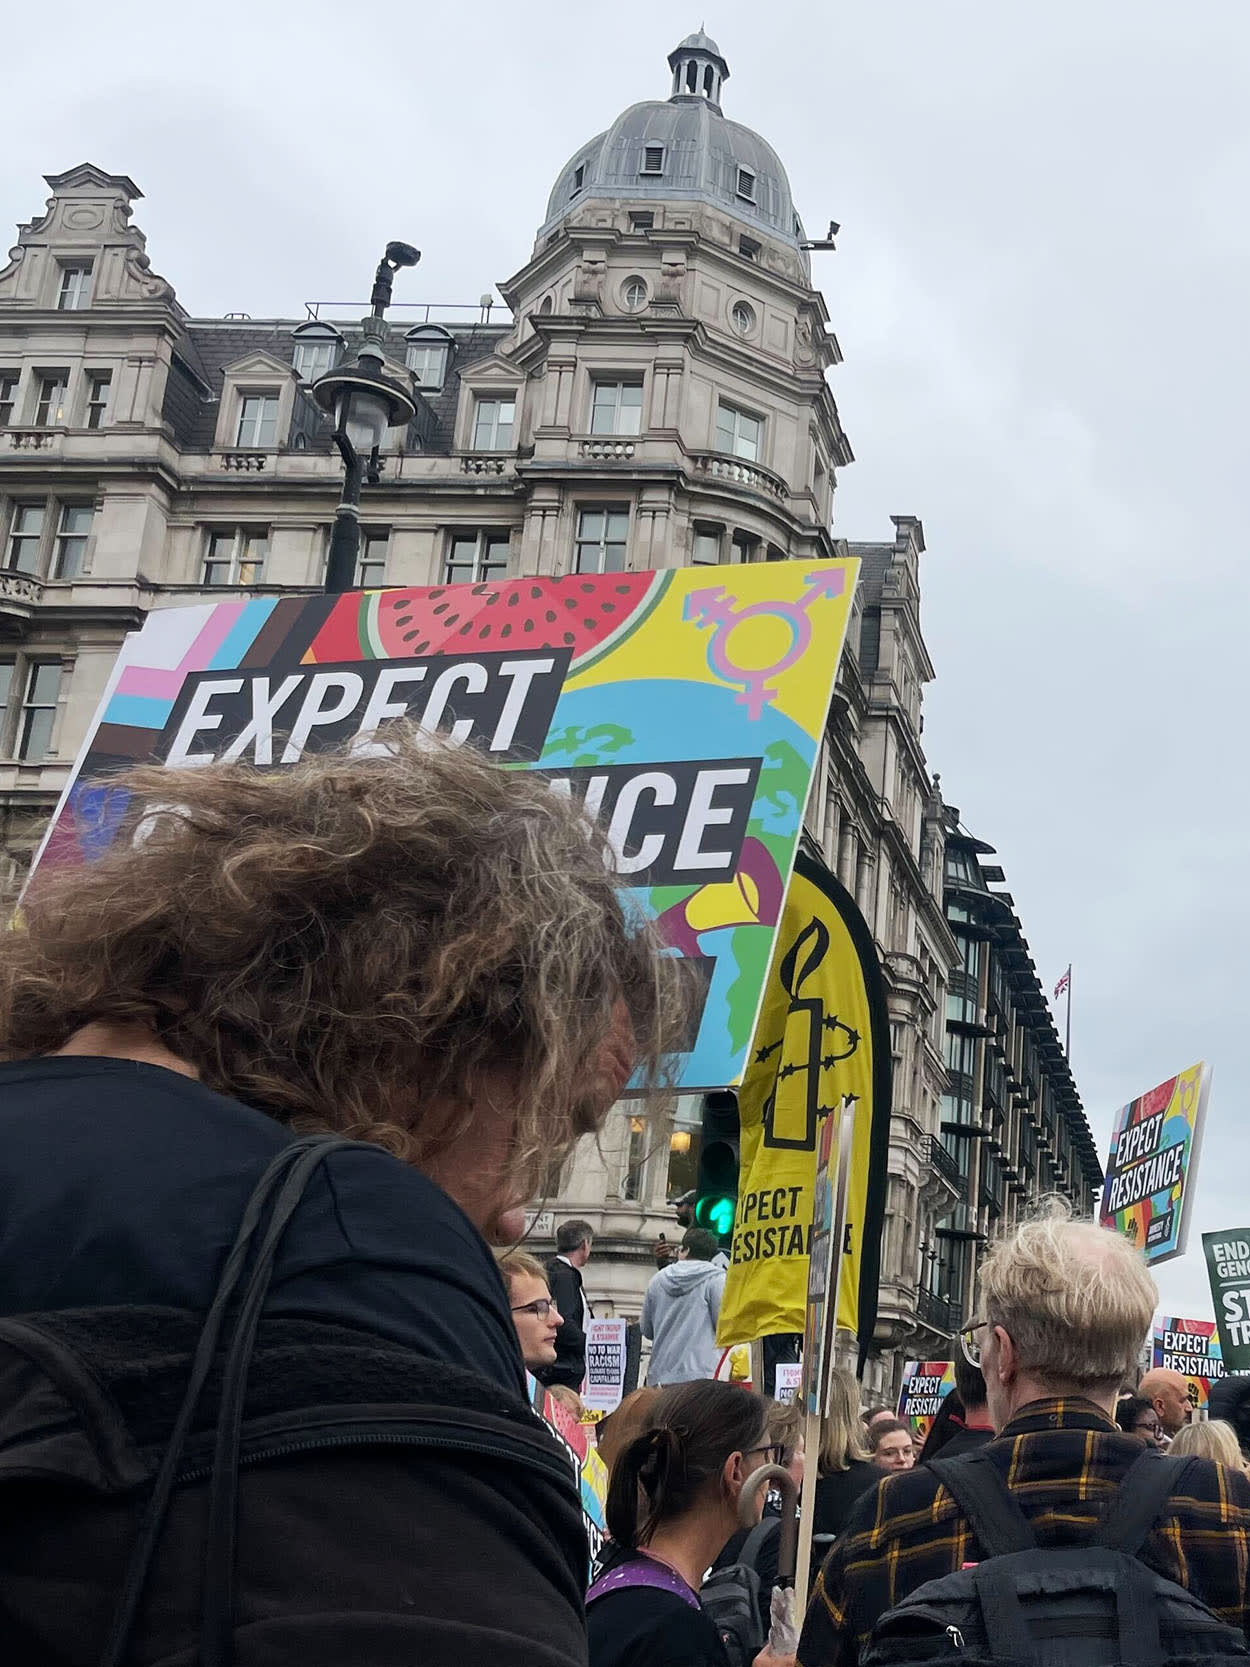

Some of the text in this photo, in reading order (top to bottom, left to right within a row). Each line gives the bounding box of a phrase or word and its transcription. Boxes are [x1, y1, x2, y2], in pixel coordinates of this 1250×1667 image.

[165, 658, 556, 767] EXPECT
[1115, 1112, 1163, 1168] EXPECT
[1108, 1143, 1184, 1213] RESISTANCE
[741, 1187, 803, 1224] PECT
[733, 1223, 853, 1264] ESISTAE
[1212, 1241, 1249, 1262] END
[1163, 1331, 1208, 1354] EXPECT
[589, 1355, 620, 1368] RACISM
[1163, 1353, 1228, 1378] RESISTANC
[908, 1376, 941, 1395] EXPECT
[904, 1397, 944, 1416] RESISTAN
